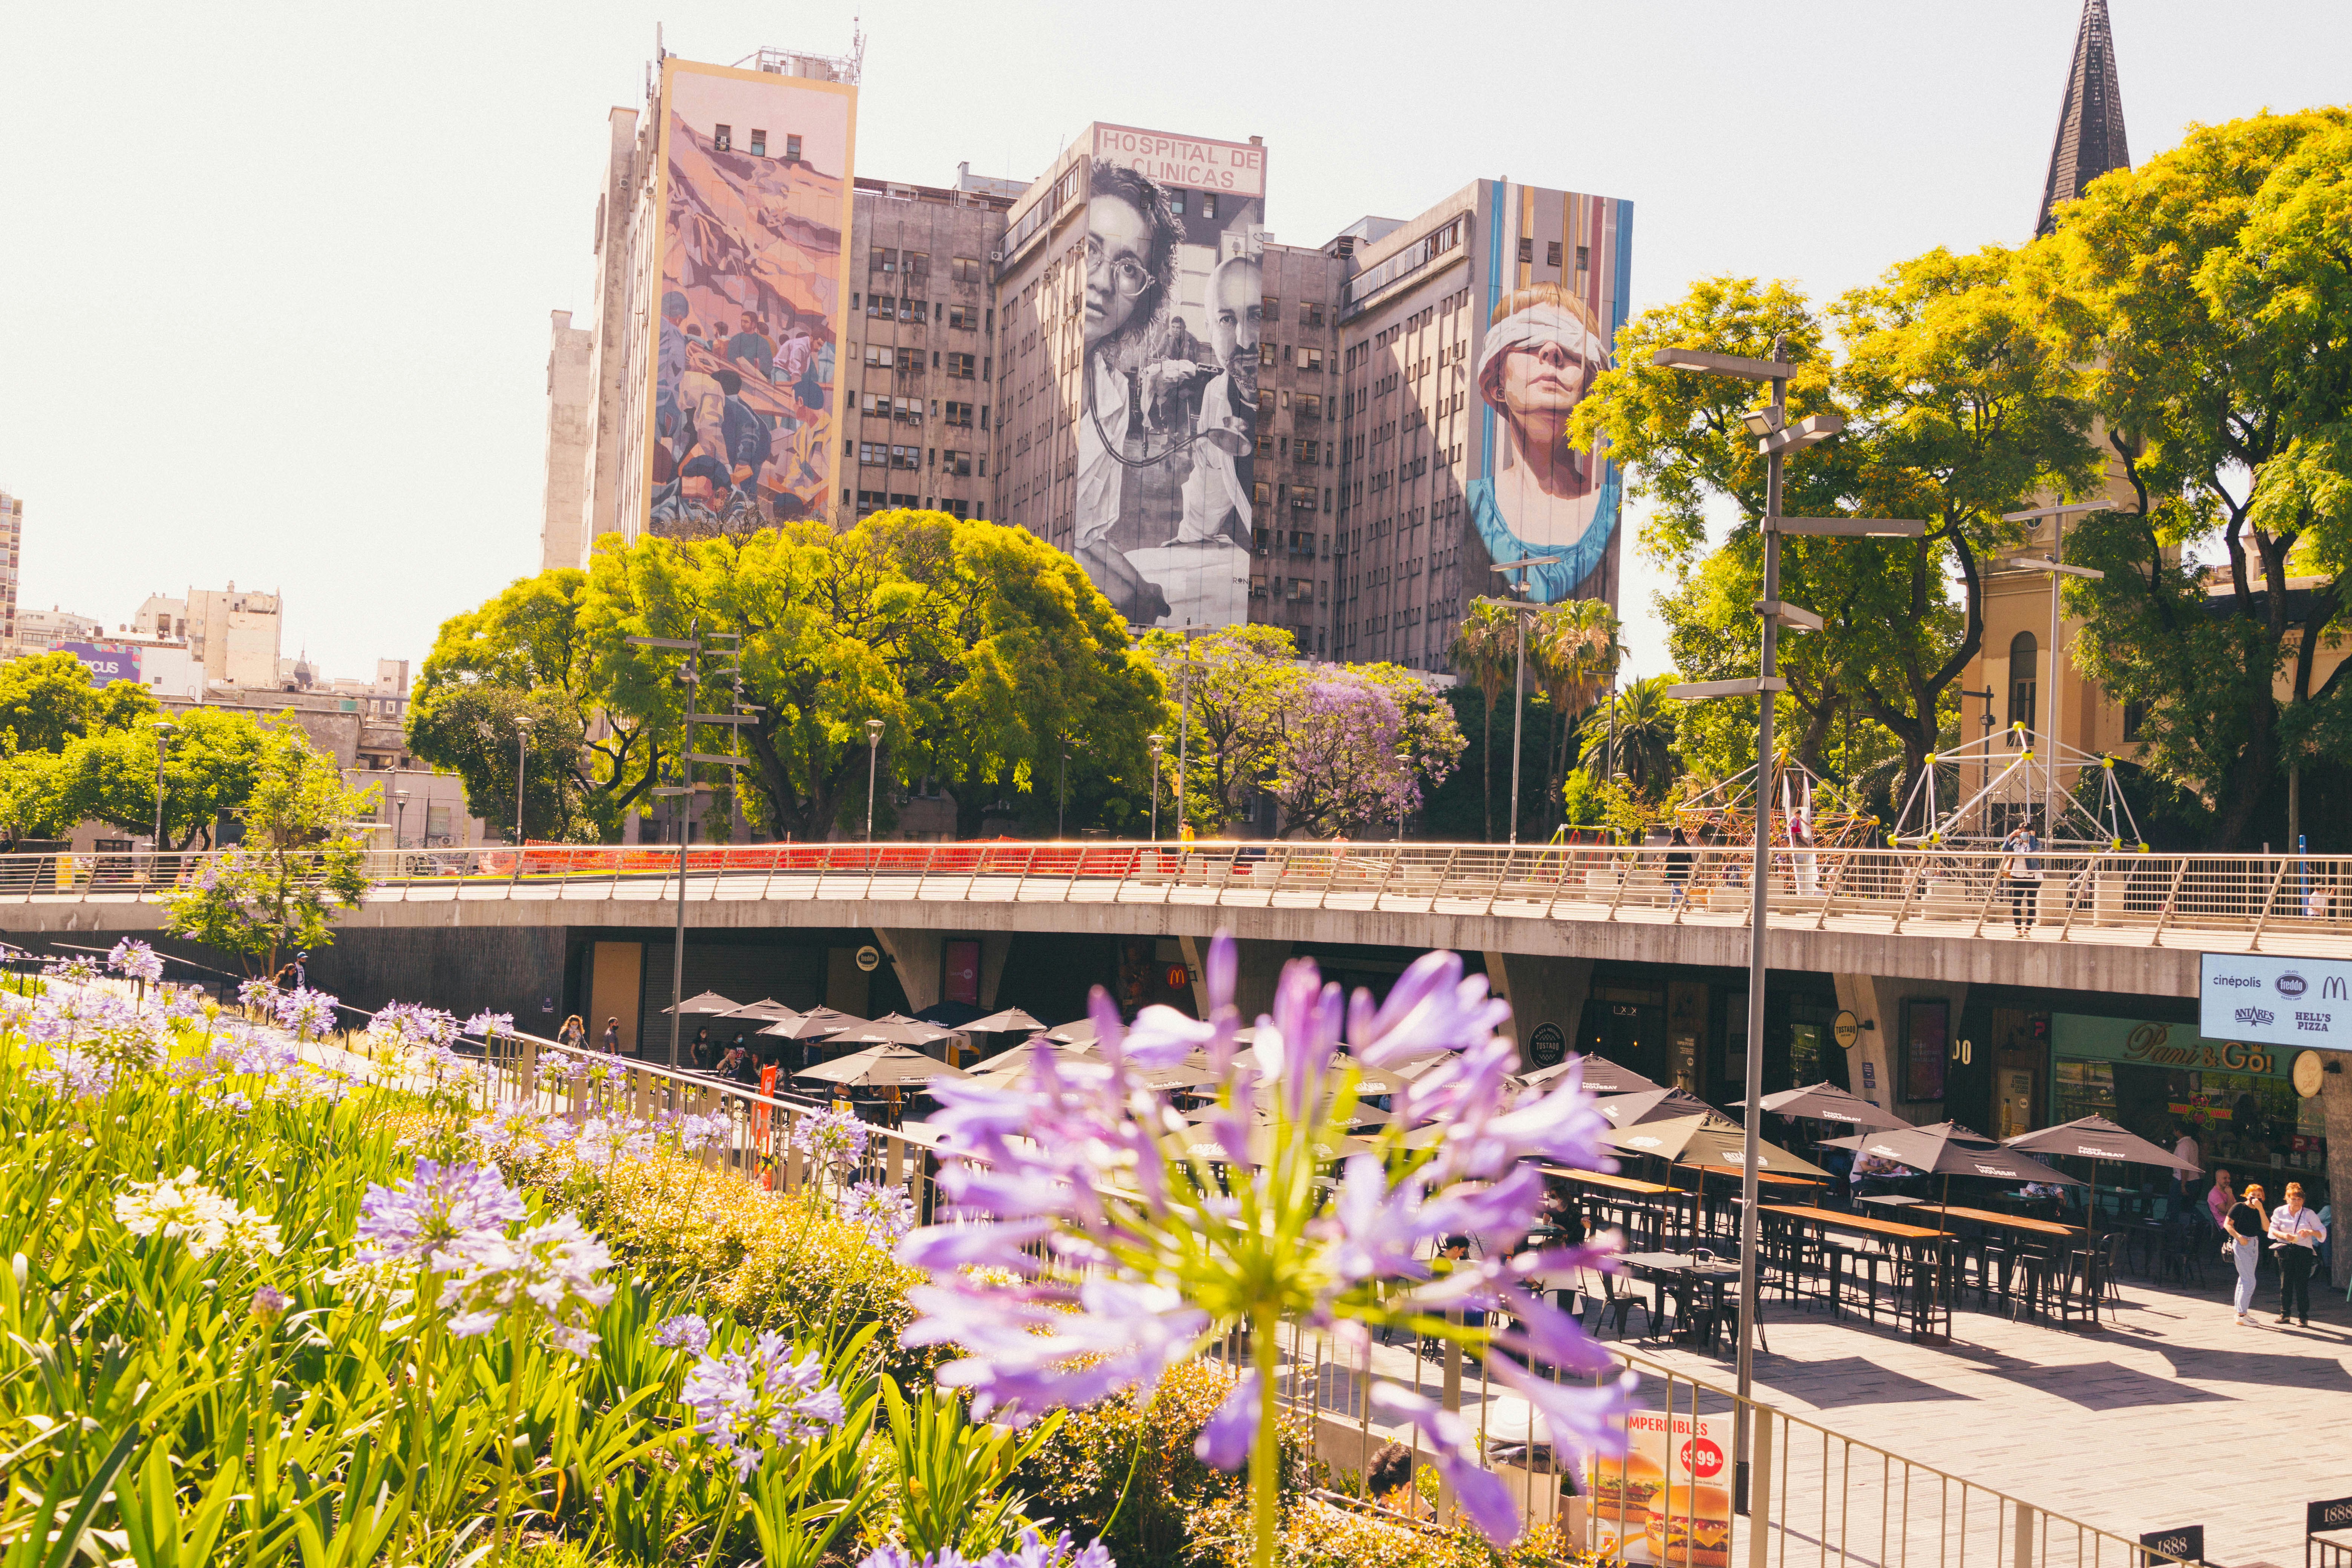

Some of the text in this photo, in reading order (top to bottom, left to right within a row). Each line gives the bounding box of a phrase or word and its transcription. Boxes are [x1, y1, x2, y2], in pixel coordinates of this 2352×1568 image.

[1104, 131, 1259, 170] HOSPITAL DE
[2213, 975, 2261, 988] cinépolis
[2280, 979, 2303, 991] freddo
[2235, 1005, 2274, 1020] ANTARES
[2295, 1012, 2331, 1022] HELL'S
[1836, 1026, 1856, 1035] TOSTADO
[2297, 1021, 2329, 1032] PIZZA
[1536, 1042, 1559, 1051] TOSTADO
[2125, 1022, 2199, 1066] Pani
[2202, 1046, 2219, 1068] &
[1824, 1113, 1862, 1122] HOUSSAY
[2169, 1104, 2231, 1118] TAKE AWAY
[2078, 1149, 2125, 1158] HOUSSAY
[1978, 1168, 2017, 1177] HOUSSAY
[1629, 1416, 1707, 1436] MPERIBLES
[2324, 1504, 2352, 1522] 1888
[2158, 1537, 2187, 1555] 1888
